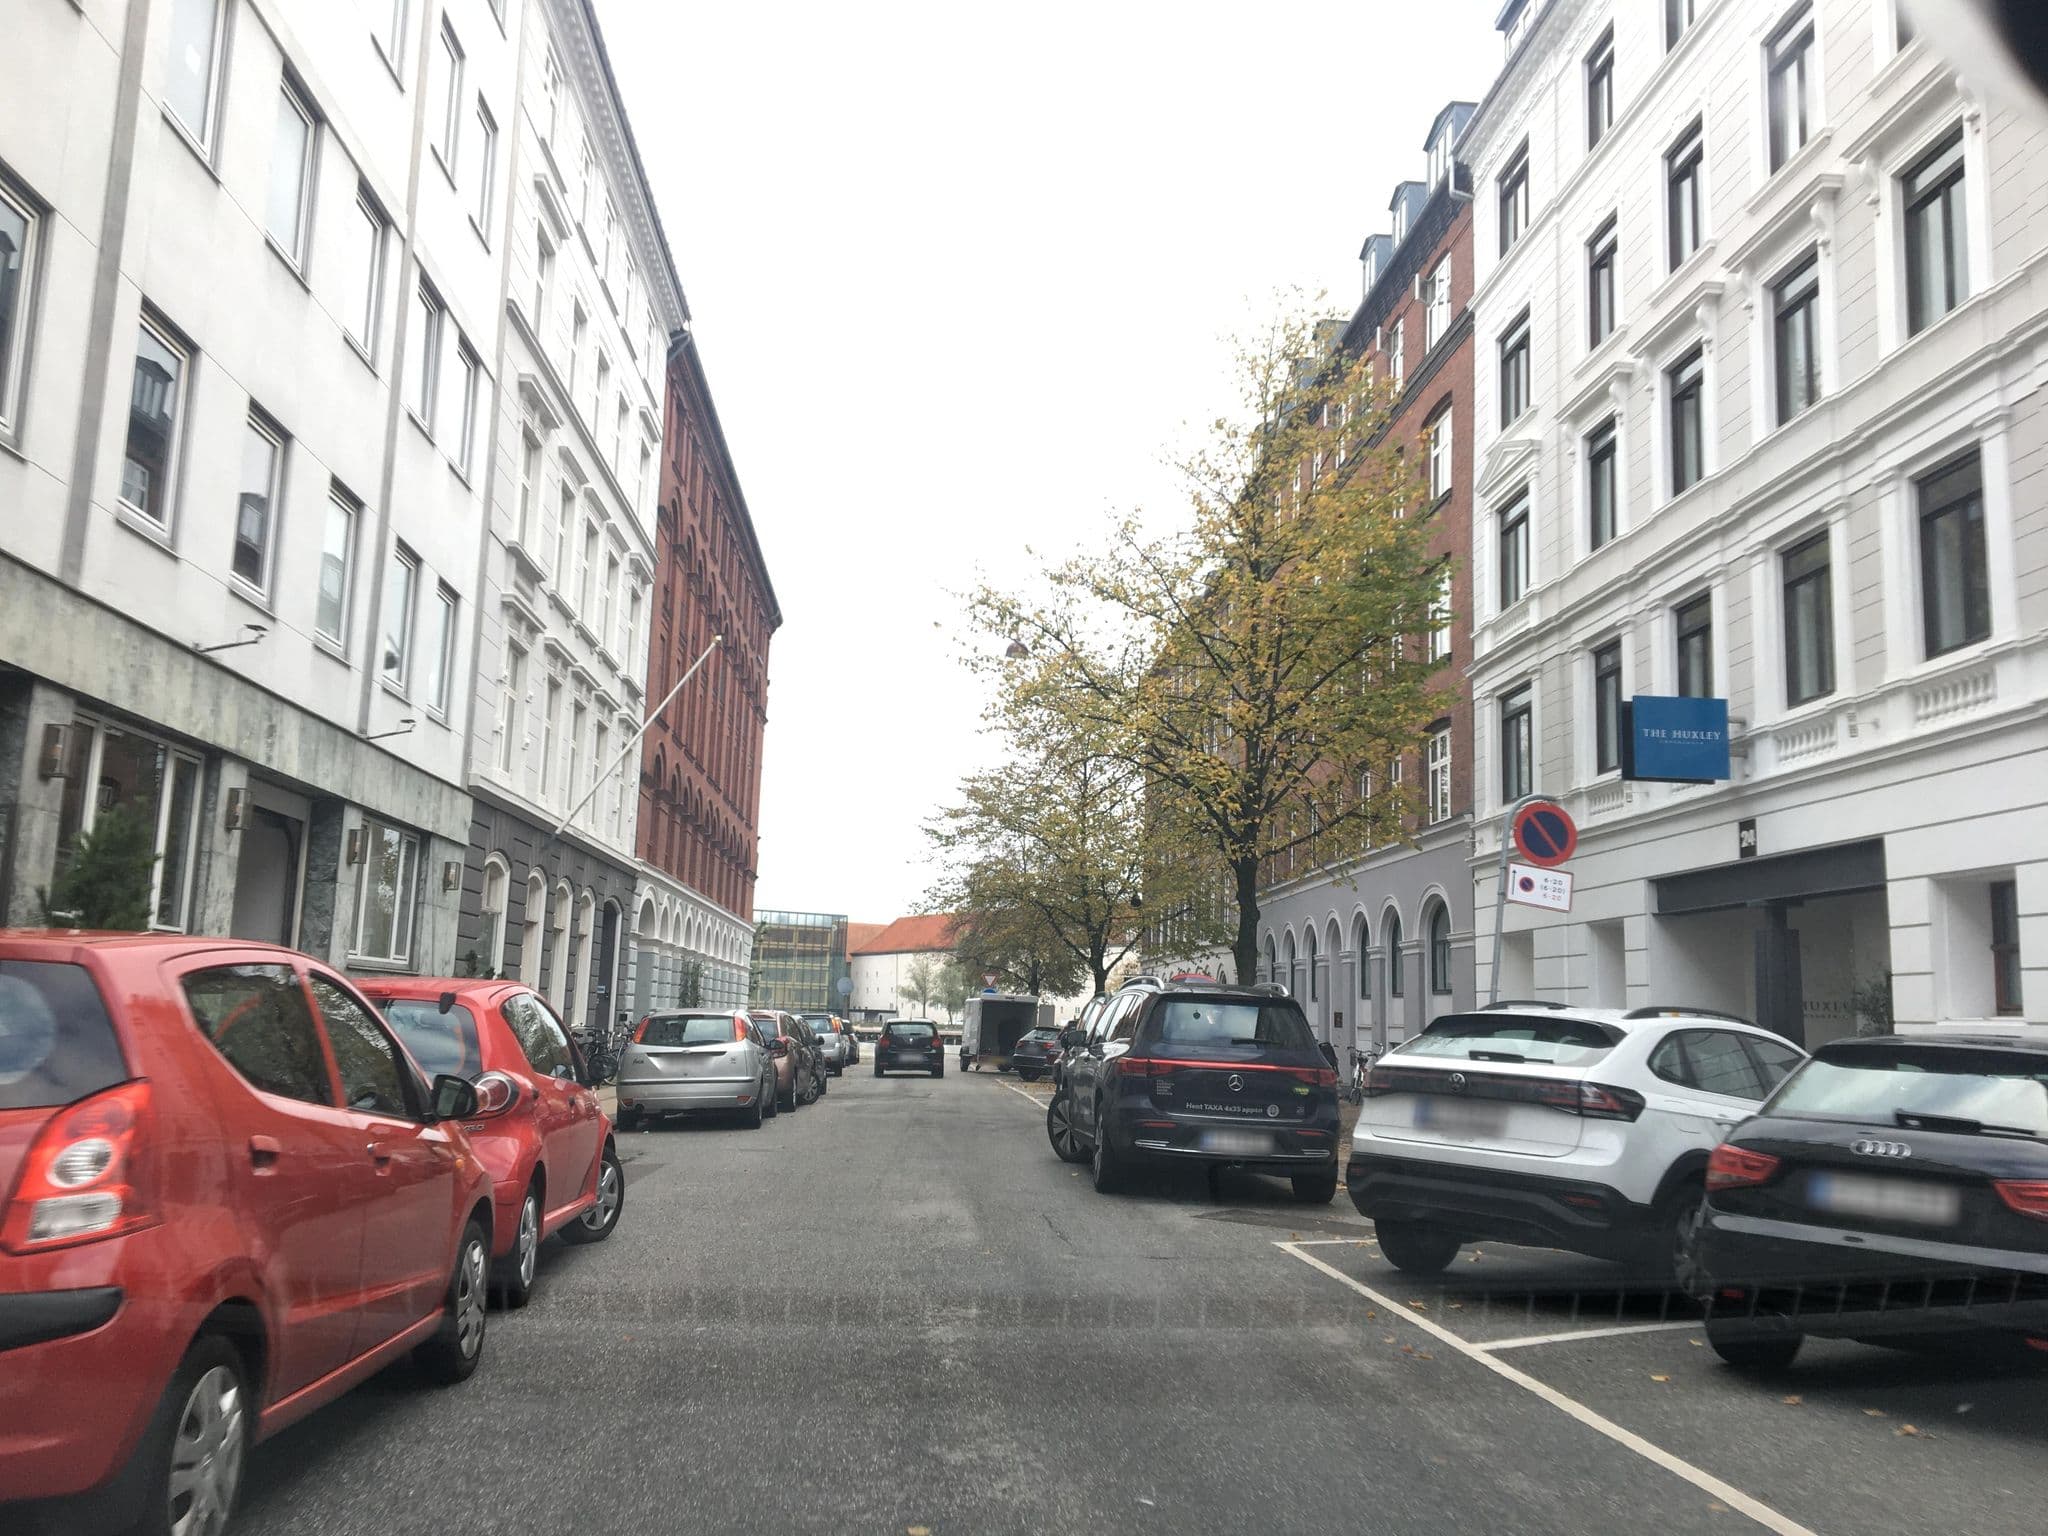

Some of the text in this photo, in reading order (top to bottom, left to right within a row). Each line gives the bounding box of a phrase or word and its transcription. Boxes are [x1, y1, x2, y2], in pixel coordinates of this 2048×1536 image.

[1643, 728, 1721, 740] THE HUXLEY
[1741, 829, 1755, 847] 24
[1204, 1103, 1224, 1111] TAXA
